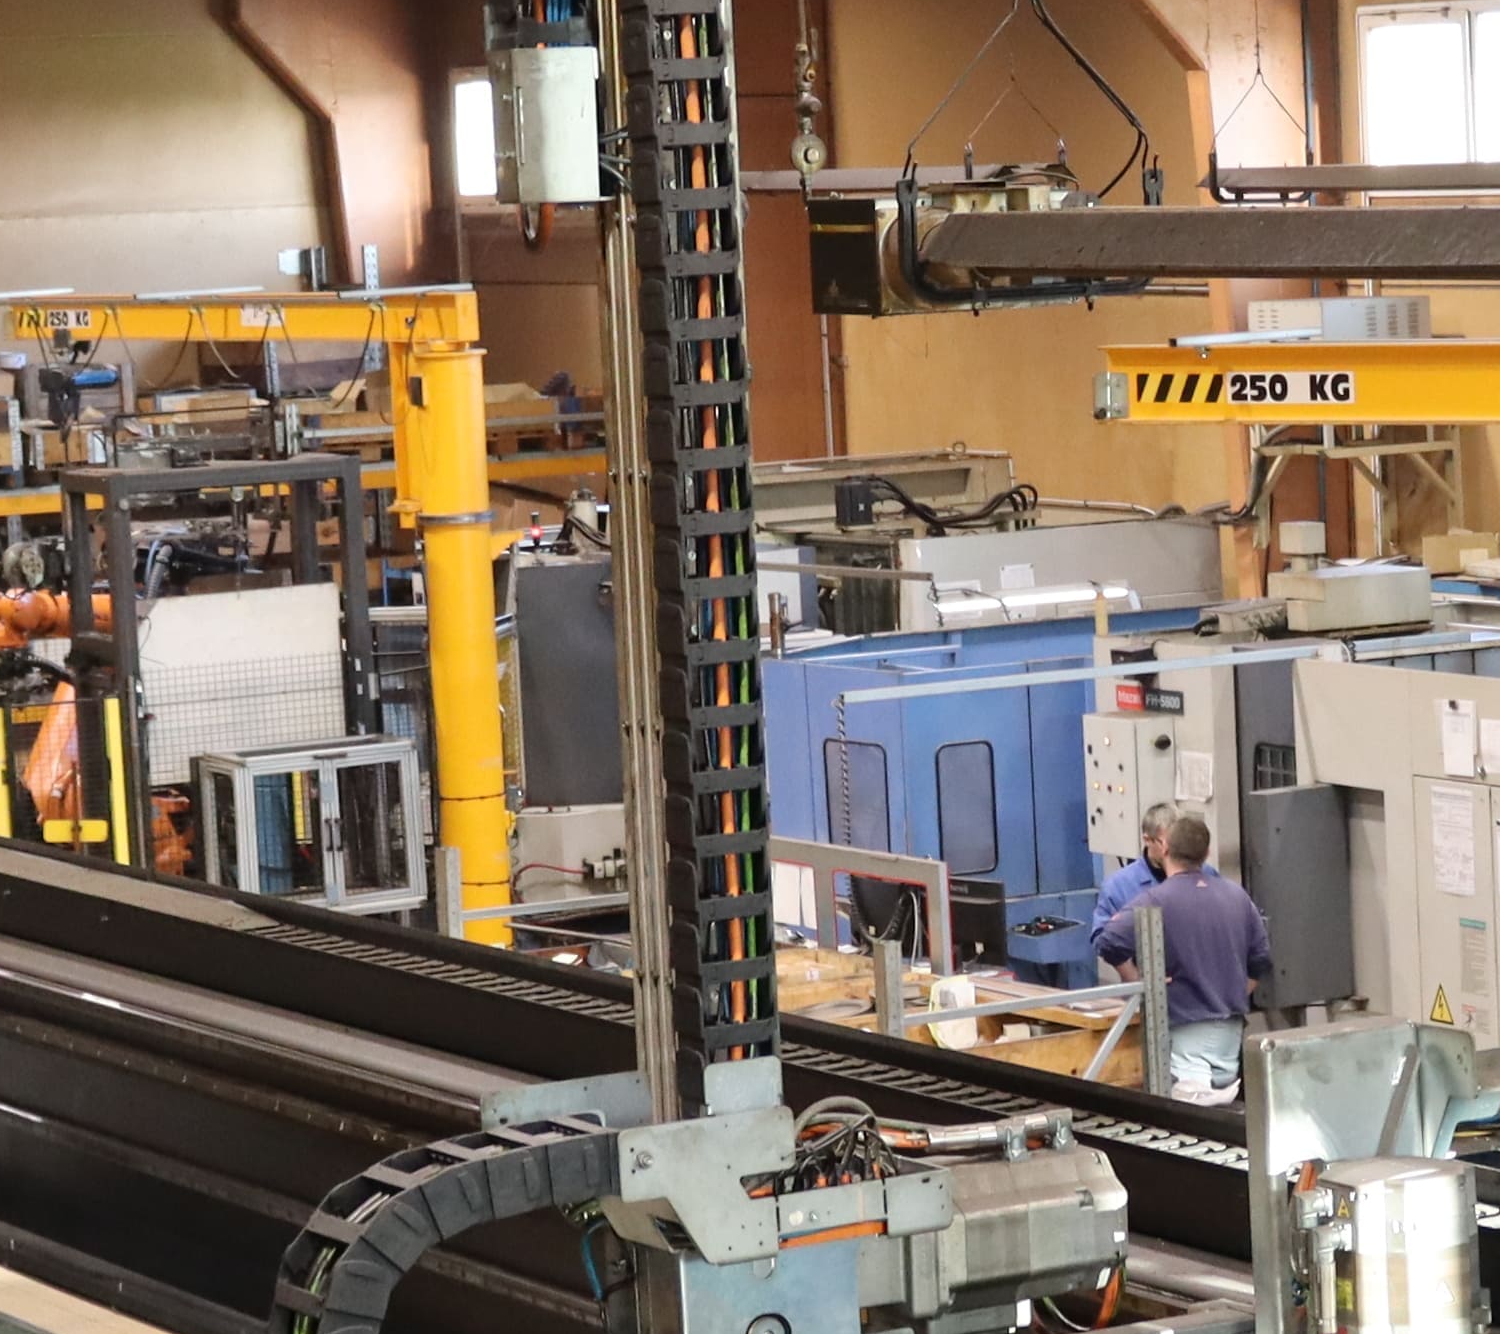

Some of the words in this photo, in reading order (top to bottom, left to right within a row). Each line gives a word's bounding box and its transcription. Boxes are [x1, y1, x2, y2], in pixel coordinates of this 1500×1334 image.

[49, 310, 69, 327] 250
[75, 310, 90, 327] KG
[1230, 373, 1289, 403] 250
[1309, 373, 1351, 402] KG
